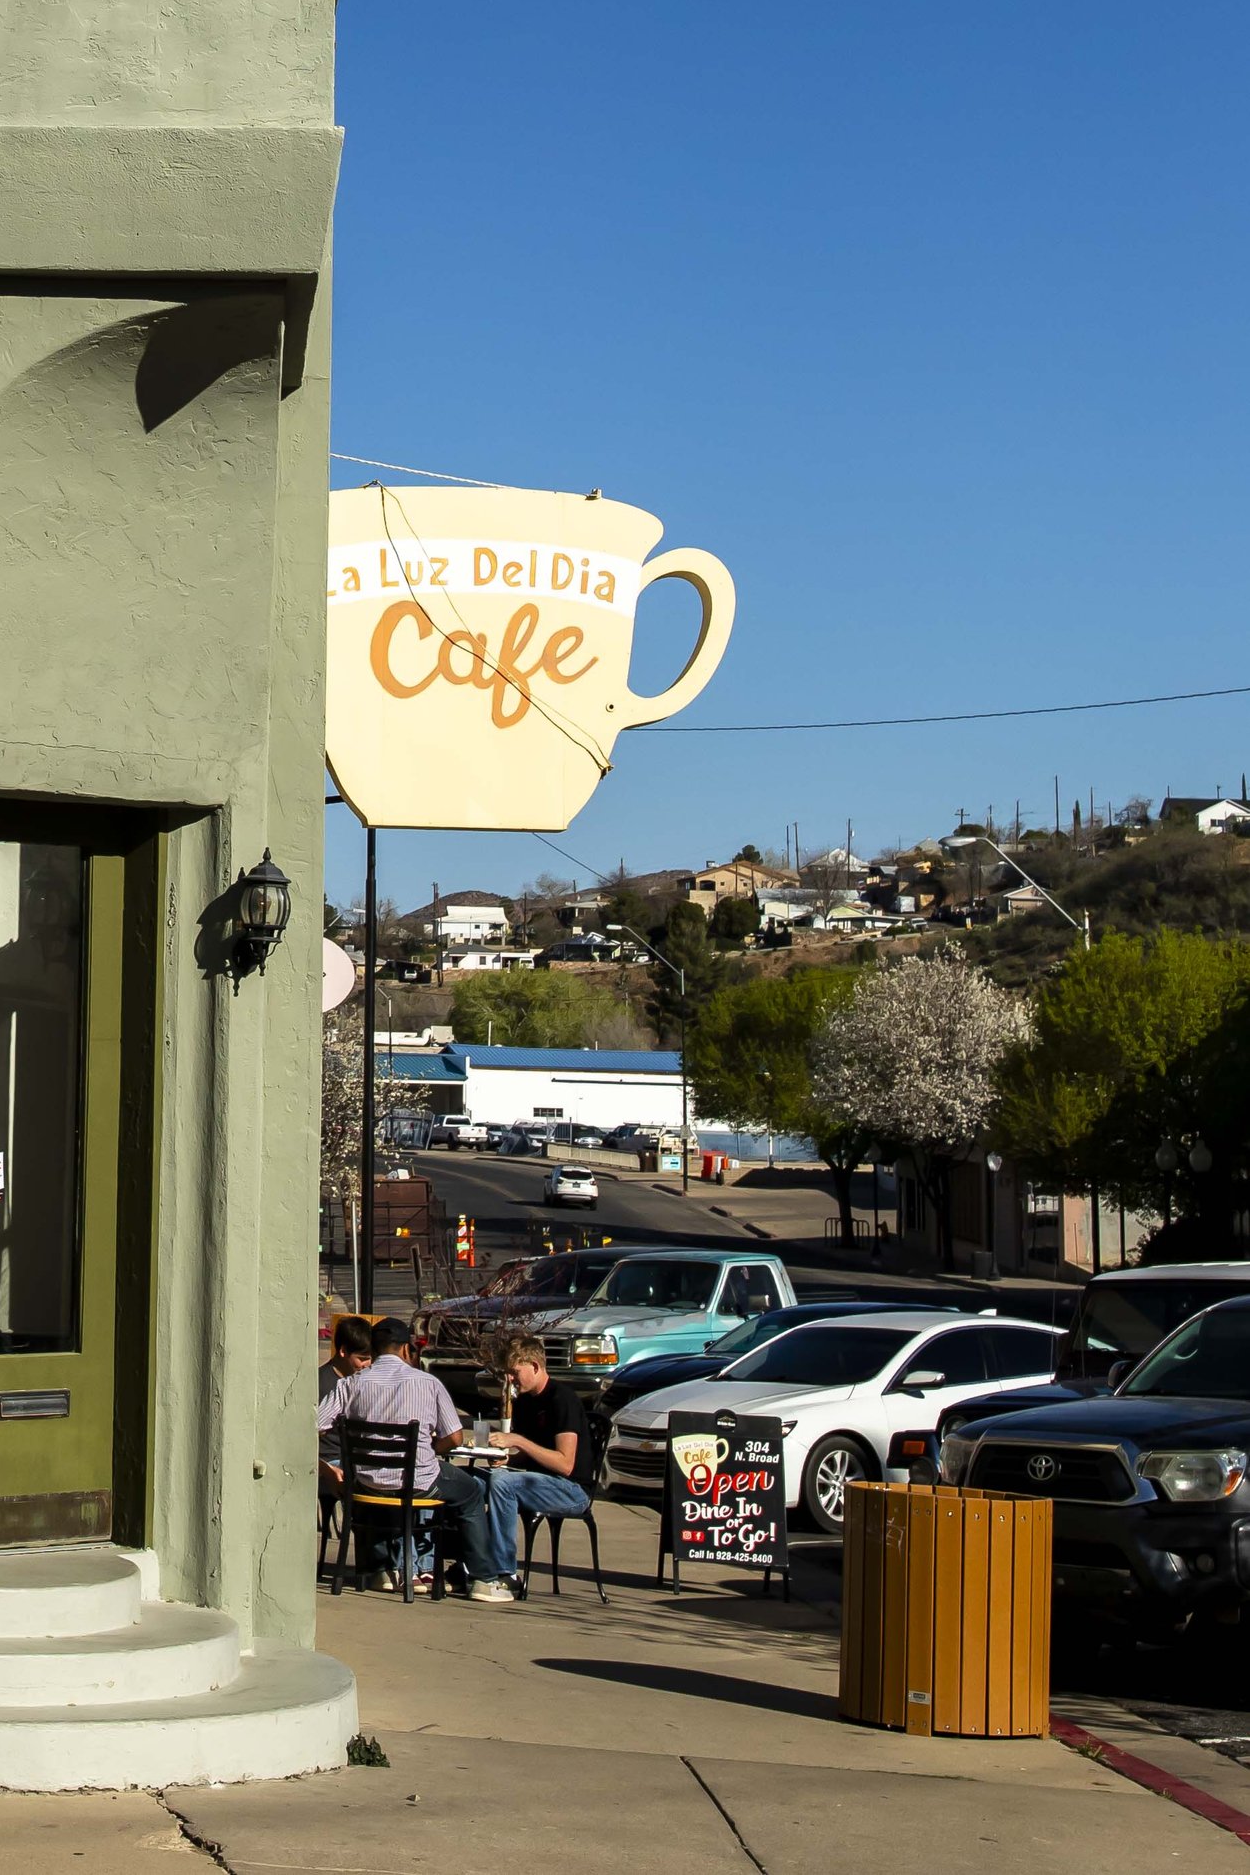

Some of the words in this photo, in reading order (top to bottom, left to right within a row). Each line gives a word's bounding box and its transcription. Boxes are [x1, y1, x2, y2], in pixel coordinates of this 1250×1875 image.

[327, 566, 361, 597] a
[379, 548, 449, 588] Luz
[473, 546, 537, 588] Del
[551, 553, 617, 604] Dia
[370, 600, 599, 729] Cafe
[744, 1440, 770, 1453] 304
[684, 1448, 713, 1464] Cafe
[735, 1451, 746, 1461] N.
[748, 1452, 780, 1463] Broad
[686, 1463, 775, 1506] Open
[682, 1500, 733, 1522] Dine
[735, 1497, 763, 1518] In
[726, 1518, 744, 1529] or
[707, 1526, 737, 1547] To
[689, 1549, 704, 1559] Call
[706, 1550, 715, 1559] In
[716, 1551, 773, 1564] 928-425-8400
